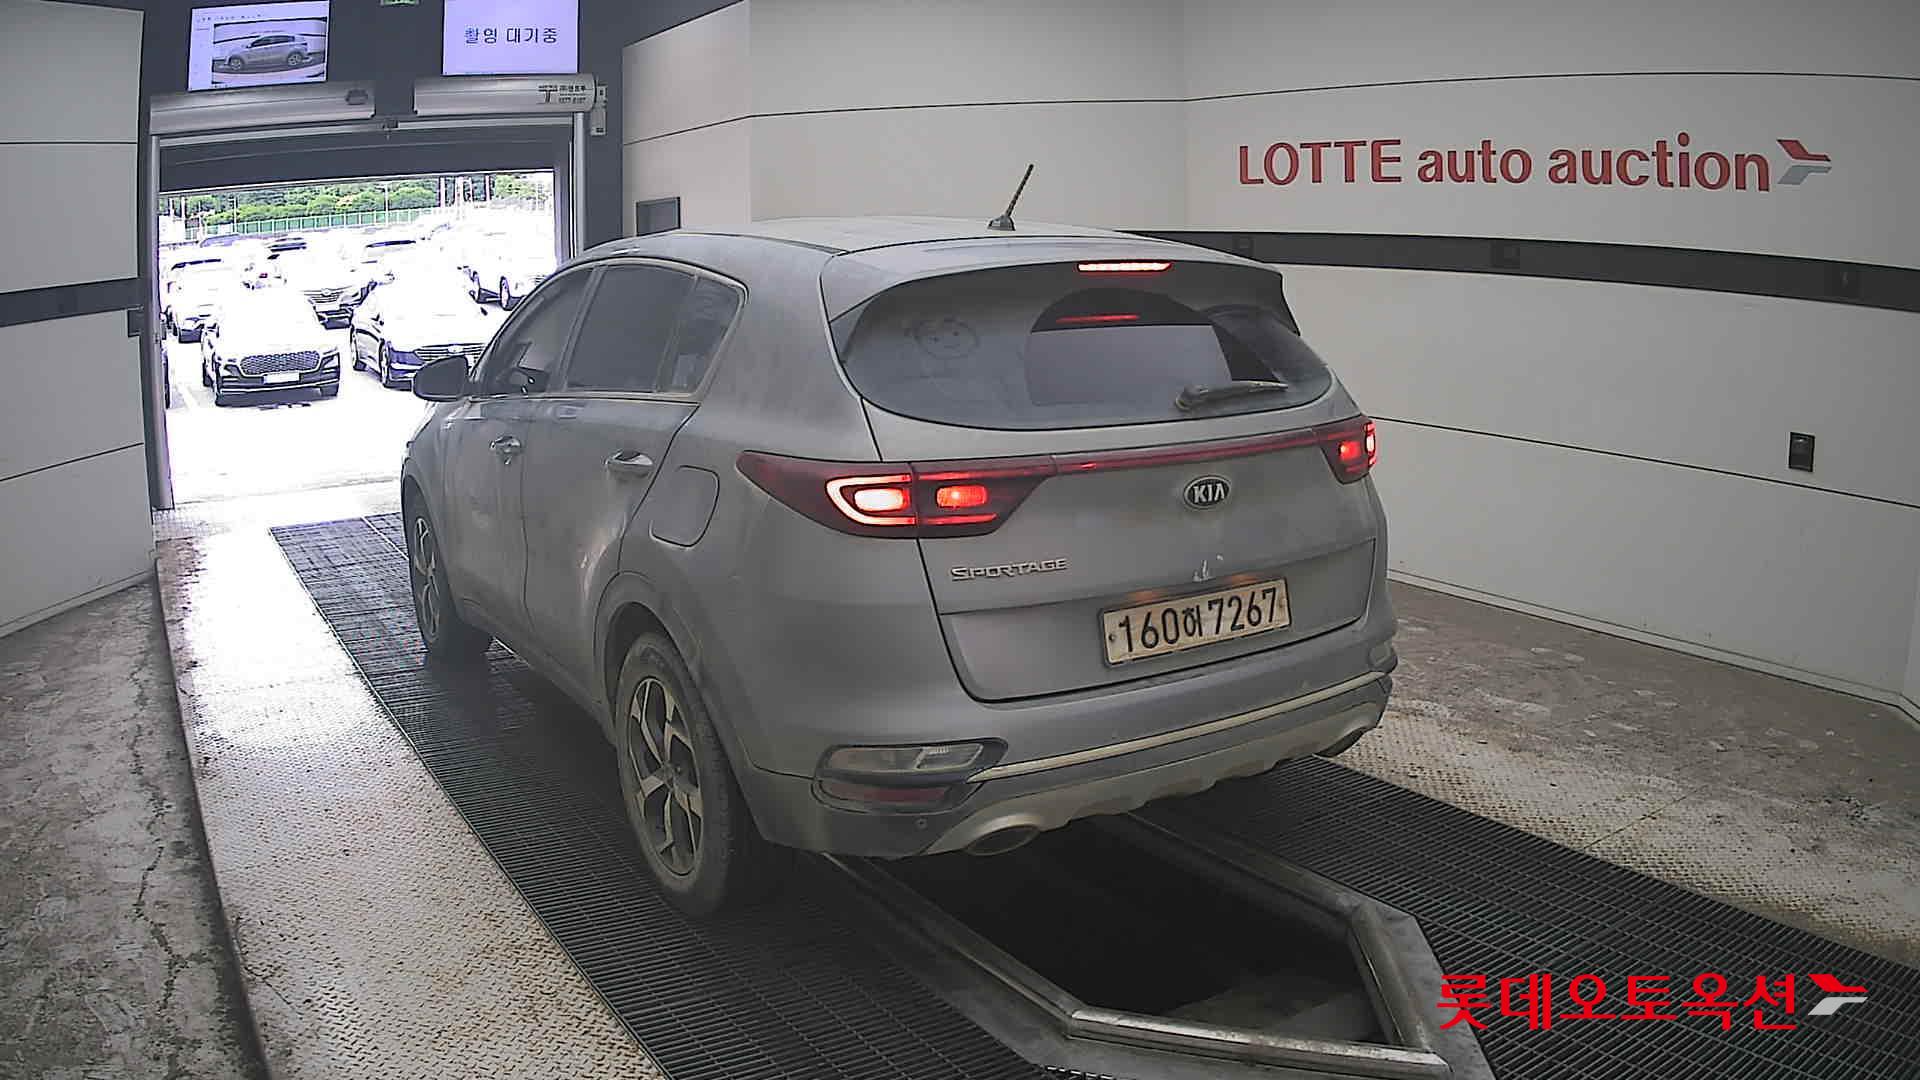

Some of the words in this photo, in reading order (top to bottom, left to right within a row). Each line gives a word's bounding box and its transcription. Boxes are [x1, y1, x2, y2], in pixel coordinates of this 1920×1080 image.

[465, 27, 498, 44] 촬영
[506, 27, 558, 44] 대기중
[1239, 139, 1402, 185] LOTTE
[1417, 139, 1532, 184] auto
[1548, 131, 1770, 192] auction
[1193, 482, 1225, 503] KIA
[951, 557, 1068, 581] SPORTAGE
